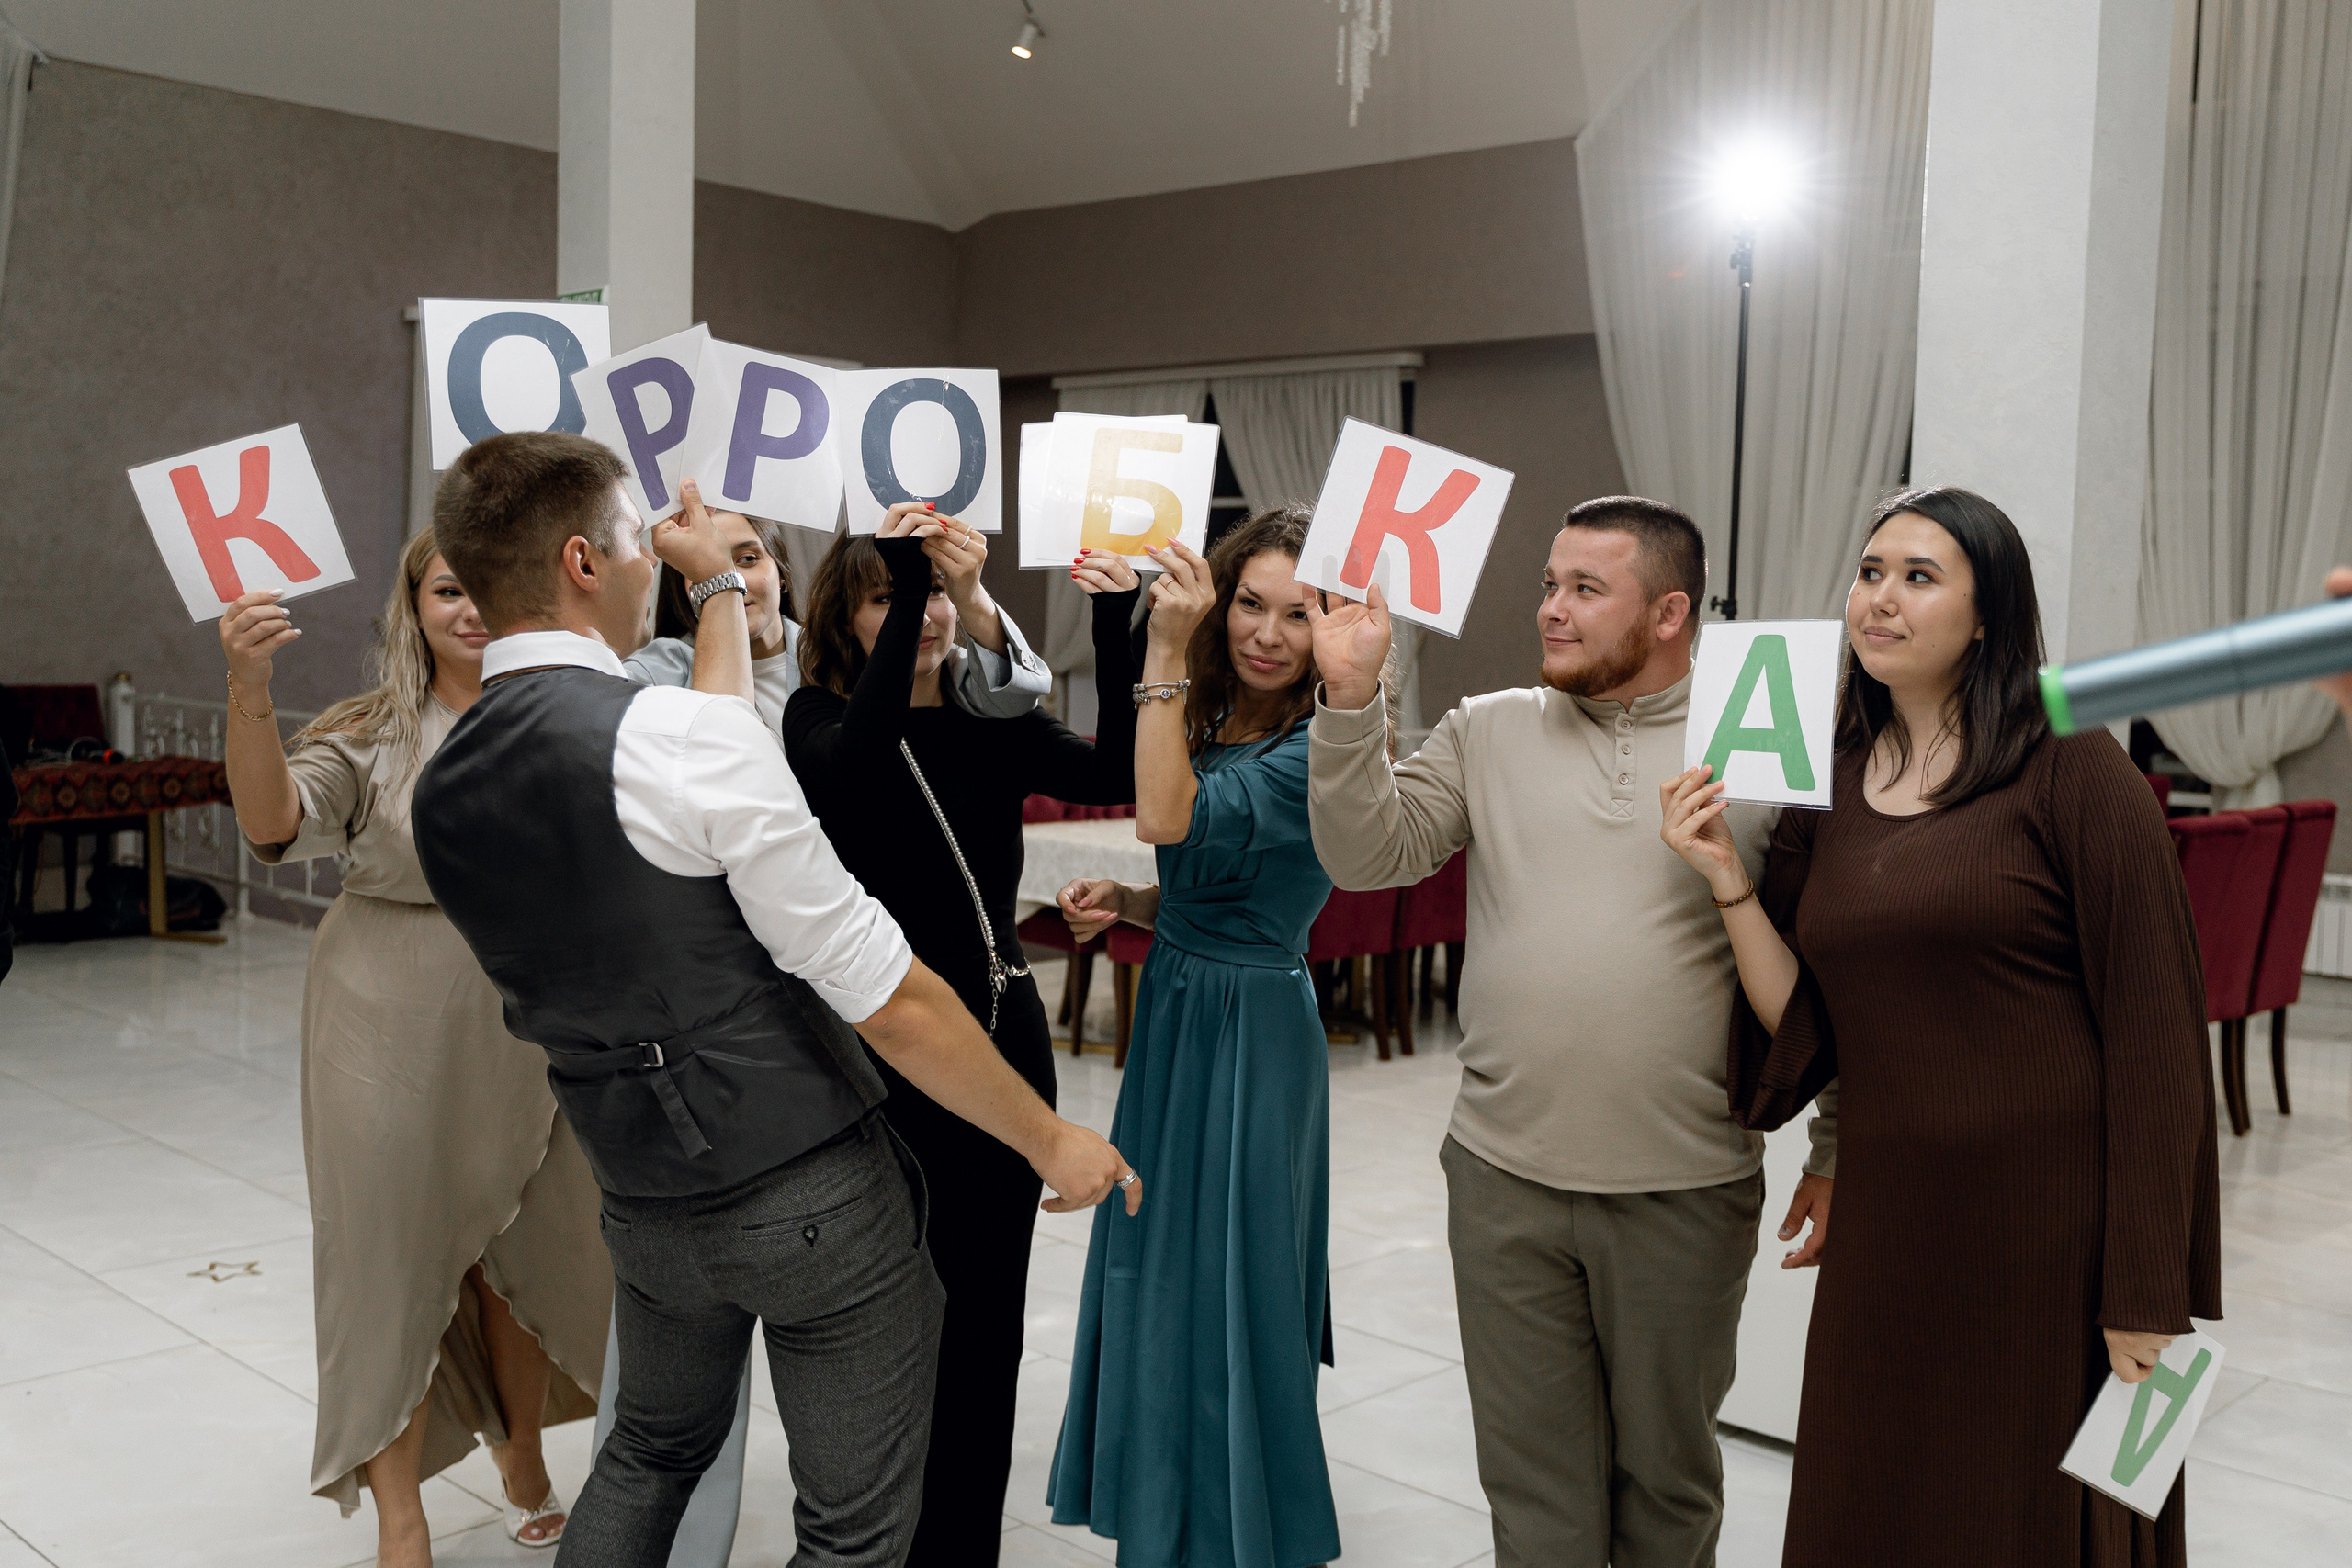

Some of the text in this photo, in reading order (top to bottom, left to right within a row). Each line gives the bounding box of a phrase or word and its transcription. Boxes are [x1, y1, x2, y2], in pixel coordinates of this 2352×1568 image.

[607, 356, 695, 512] Р
[721, 360, 830, 502] Р
[861, 378, 987, 517] О
[1080, 427, 1184, 557] Б
[168, 445, 322, 603] К
[1339, 444, 1481, 615] К
[1702, 634, 1816, 792] А
[2110, 1348, 2212, 1487] А
